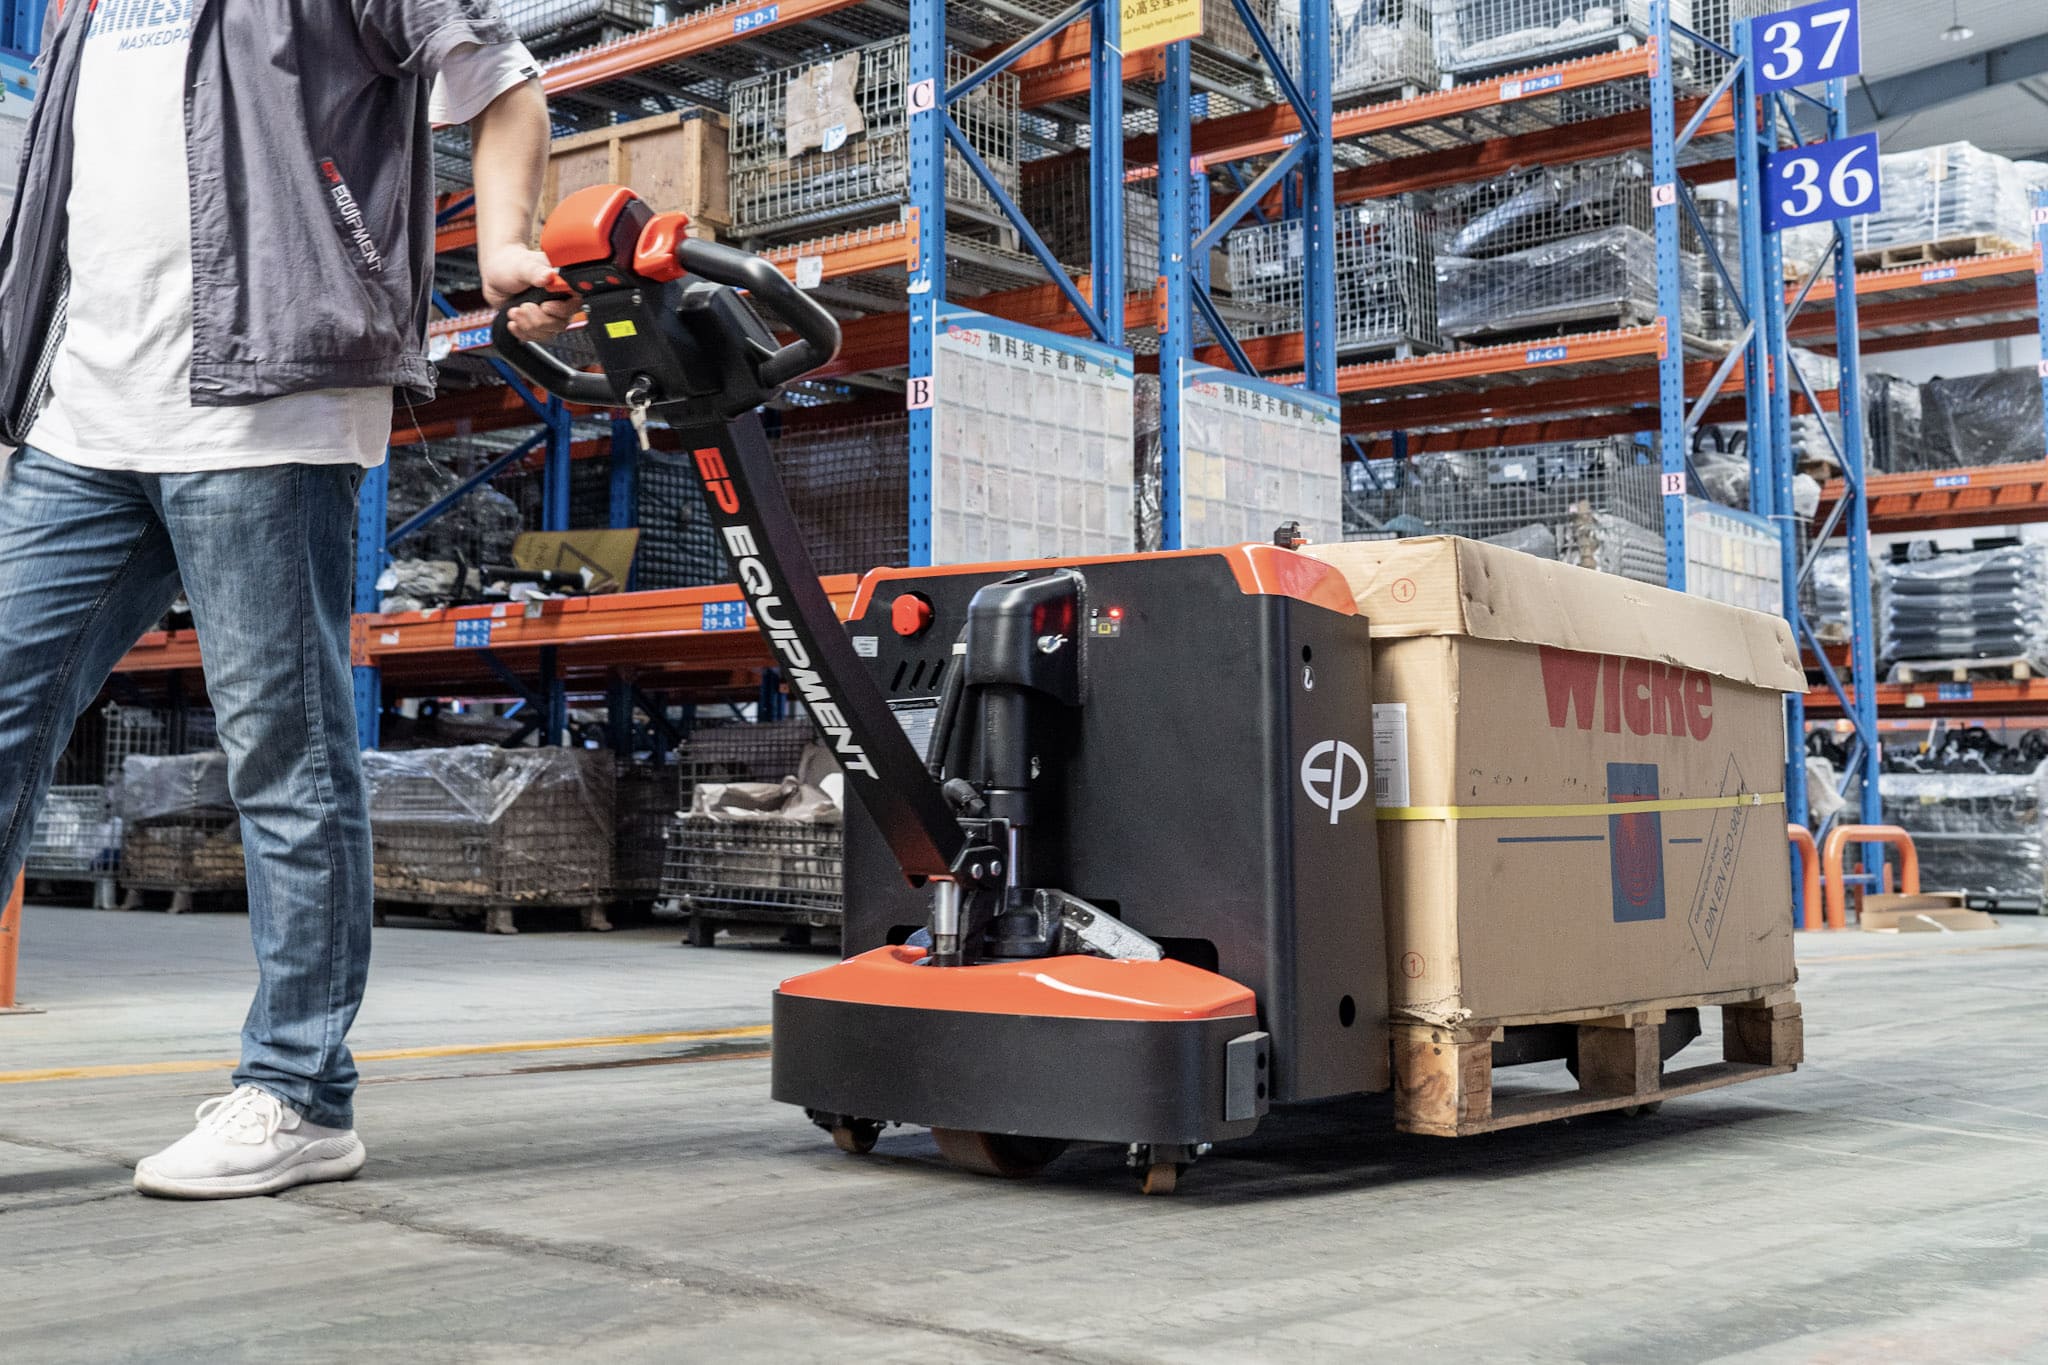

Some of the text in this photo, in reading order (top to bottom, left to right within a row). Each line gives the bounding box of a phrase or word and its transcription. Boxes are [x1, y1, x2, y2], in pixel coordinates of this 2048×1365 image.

[735, 5, 779, 31] 39-D-1
[1762, 8, 1850, 80] 37
[913, 83, 931, 108] C
[1656, 185, 1671, 203] C
[1781, 145, 1873, 217] 36
[331, 184, 382, 271] EQUIPMENT
[988, 333, 1087, 374] 物料货卡看板
[912, 380, 929, 405] B
[1223, 385, 1303, 420] 物料货卡看板
[1667, 475, 1680, 491] B
[694, 447, 880, 780] EP EQUIPMENT
[704, 603, 743, 615] 39-B-1
[704, 616, 743, 629] 39-A-1
[1301, 740, 1369, 824] EP
[1705, 898, 1718, 939] DIN
[1714, 867, 1726, 902] EN
[1720, 833, 1734, 872] ISO
